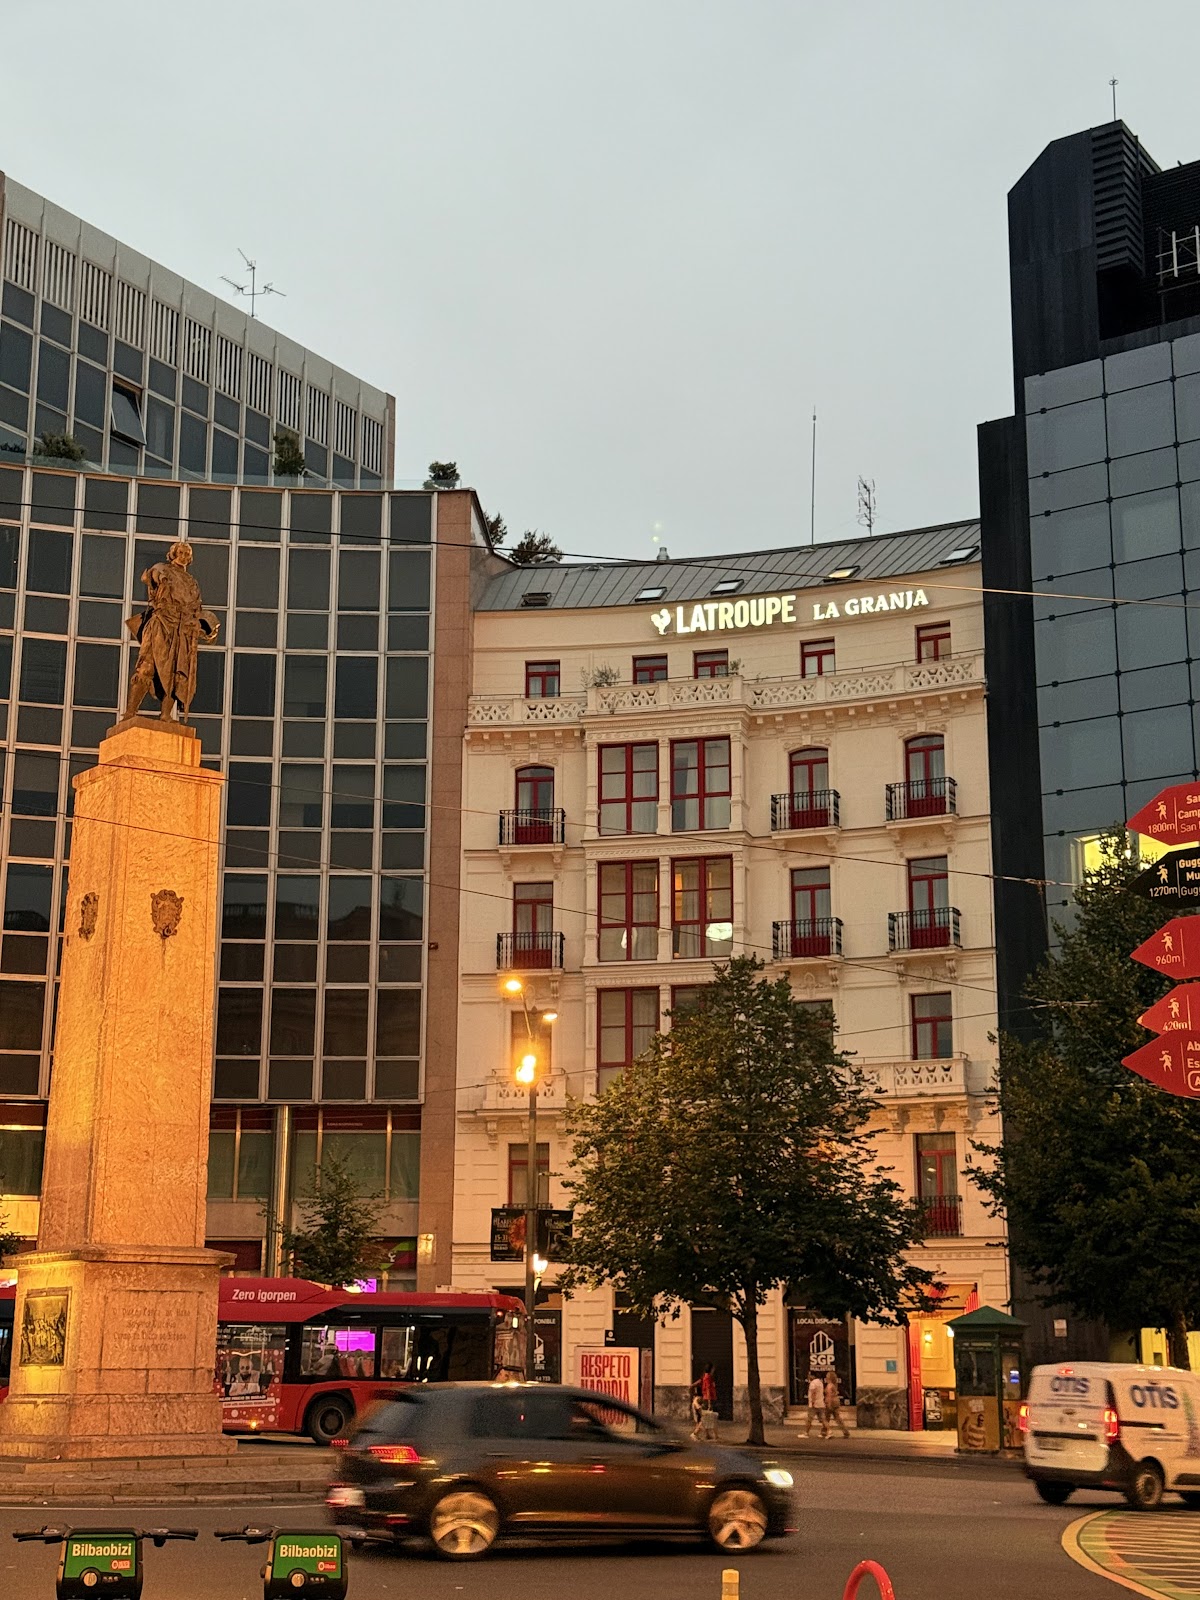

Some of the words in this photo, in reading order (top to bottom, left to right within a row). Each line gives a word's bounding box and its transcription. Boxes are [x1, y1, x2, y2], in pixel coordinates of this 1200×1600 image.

[813, 602, 840, 620] LA
[845, 589, 929, 615] GRANJA
[676, 595, 796, 633] LATROUPE
[1148, 821, 1175, 834] 1800m
[1180, 822, 1197, 833] San
[1149, 885, 1178, 897] 1270m
[1180, 886, 1200, 897] Gug
[1155, 954, 1181, 965] 960m
[1163, 1020, 1188, 1031] 420m
[232, 1289, 255, 1300] Zero
[257, 1289, 297, 1303] igorpen
[581, 1355, 630, 1378] RESPETO
[810, 1355, 835, 1365] SGP
[1051, 1377, 1090, 1393] OTIS
[1130, 1385, 1179, 1409] OTIS
[72, 1543, 132, 1557] Bilbaobizi
[280, 1544, 338, 1557] Bilbaobizi
